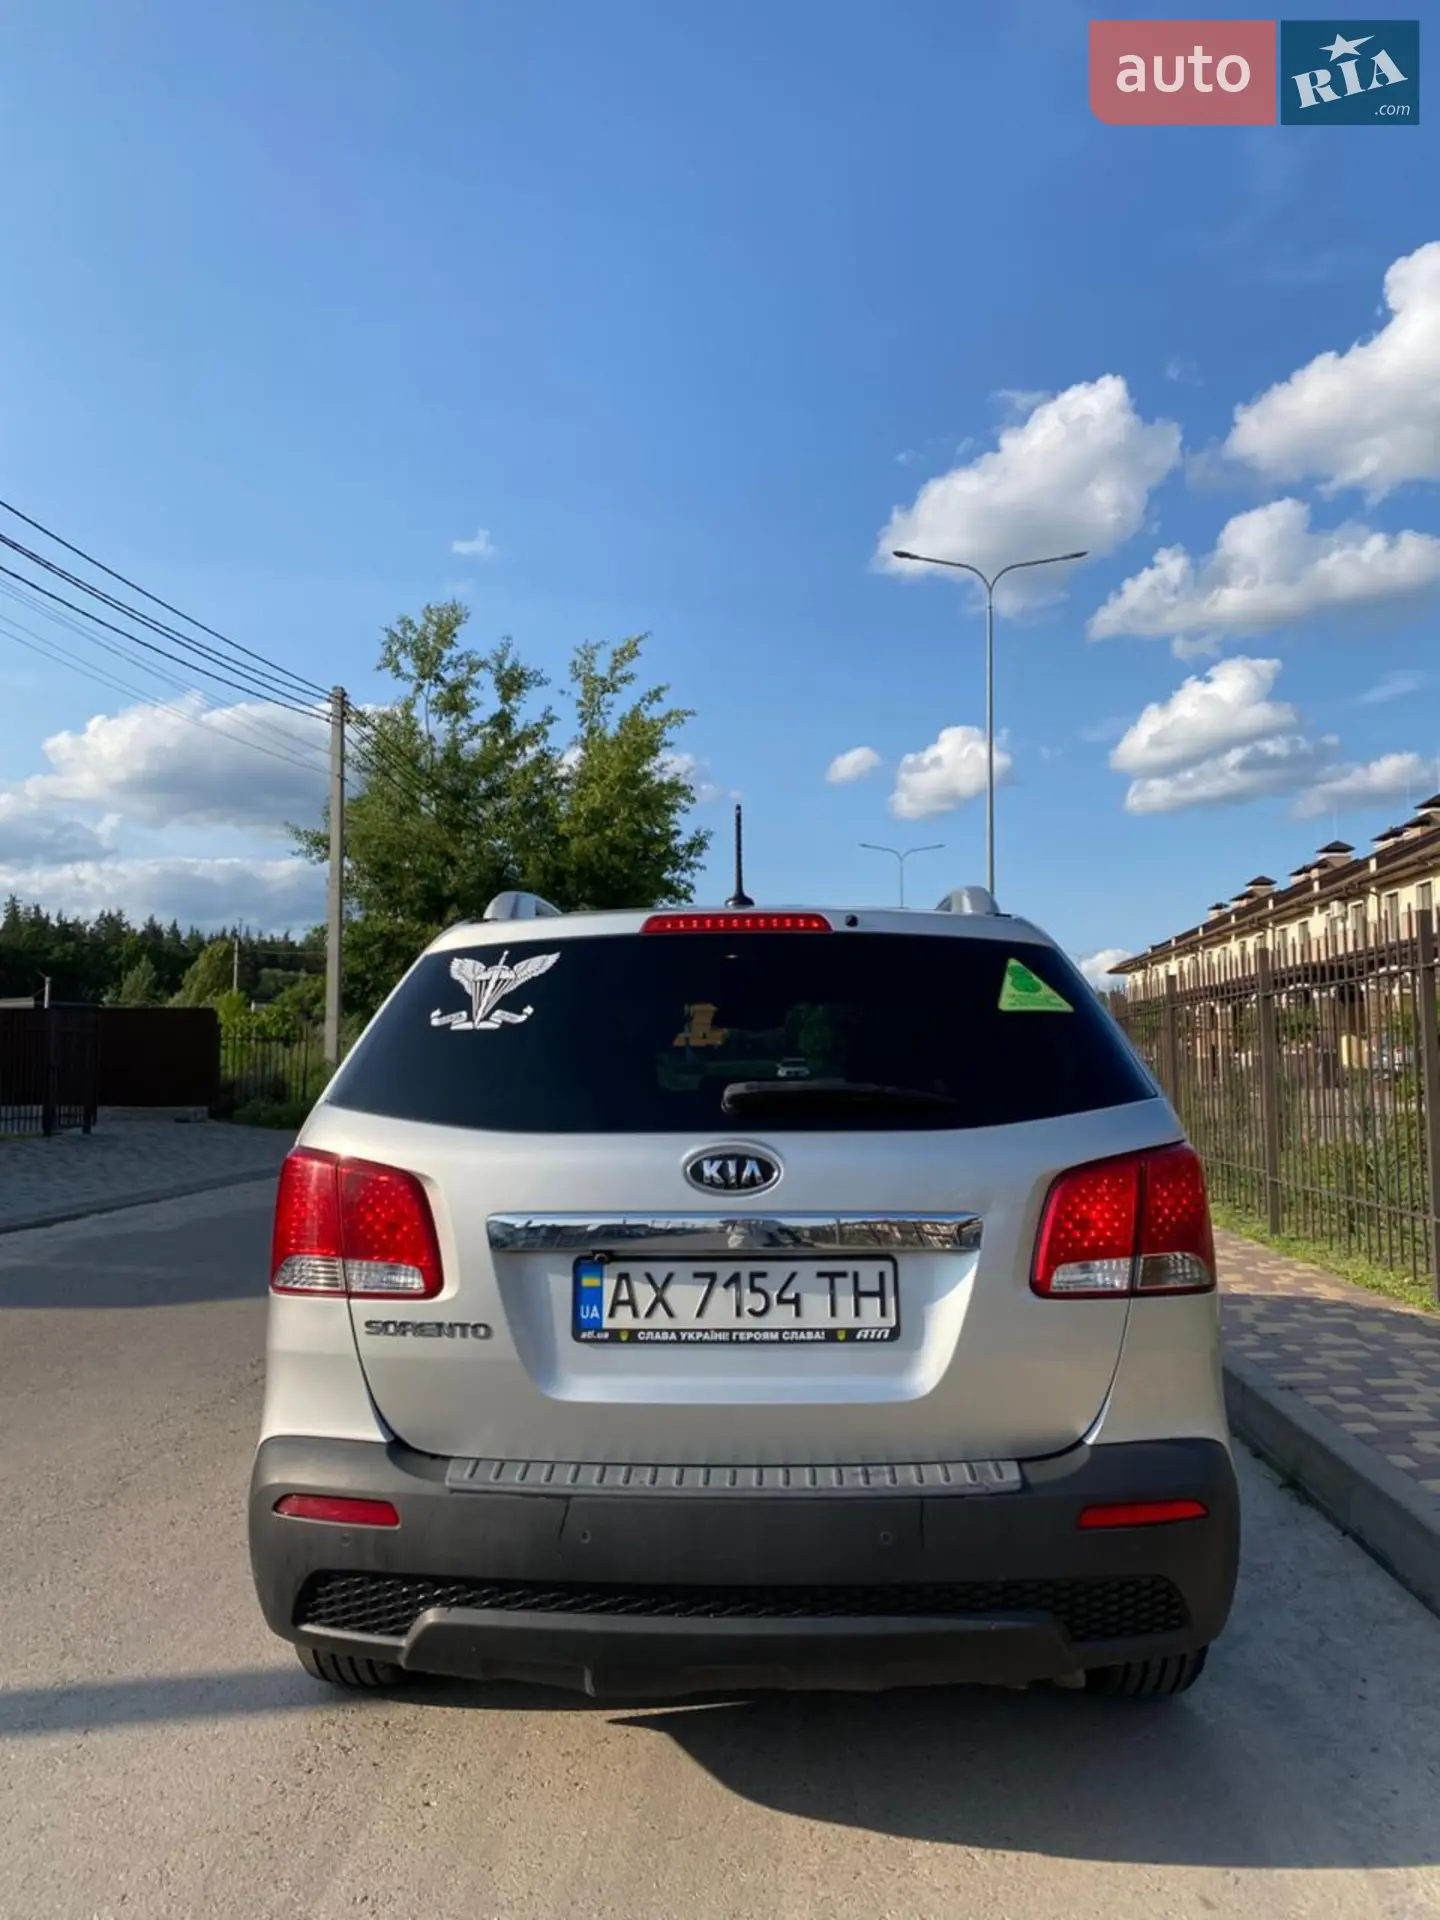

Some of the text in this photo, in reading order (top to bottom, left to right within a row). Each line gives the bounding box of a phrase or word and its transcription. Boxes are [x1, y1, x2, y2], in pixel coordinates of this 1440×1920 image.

[702, 1159, 764, 1185] KIA
[607, 1271, 888, 1319] AX 7154 TH
[580, 1305, 600, 1319] UA
[364, 1319, 493, 1341] SORENTO
[637, 1331, 677, 1341] СЛАВА
[732, 1331, 779, 1341] ГЕРОЯМ
[782, 1330, 826, 1341] СЛАВА!
